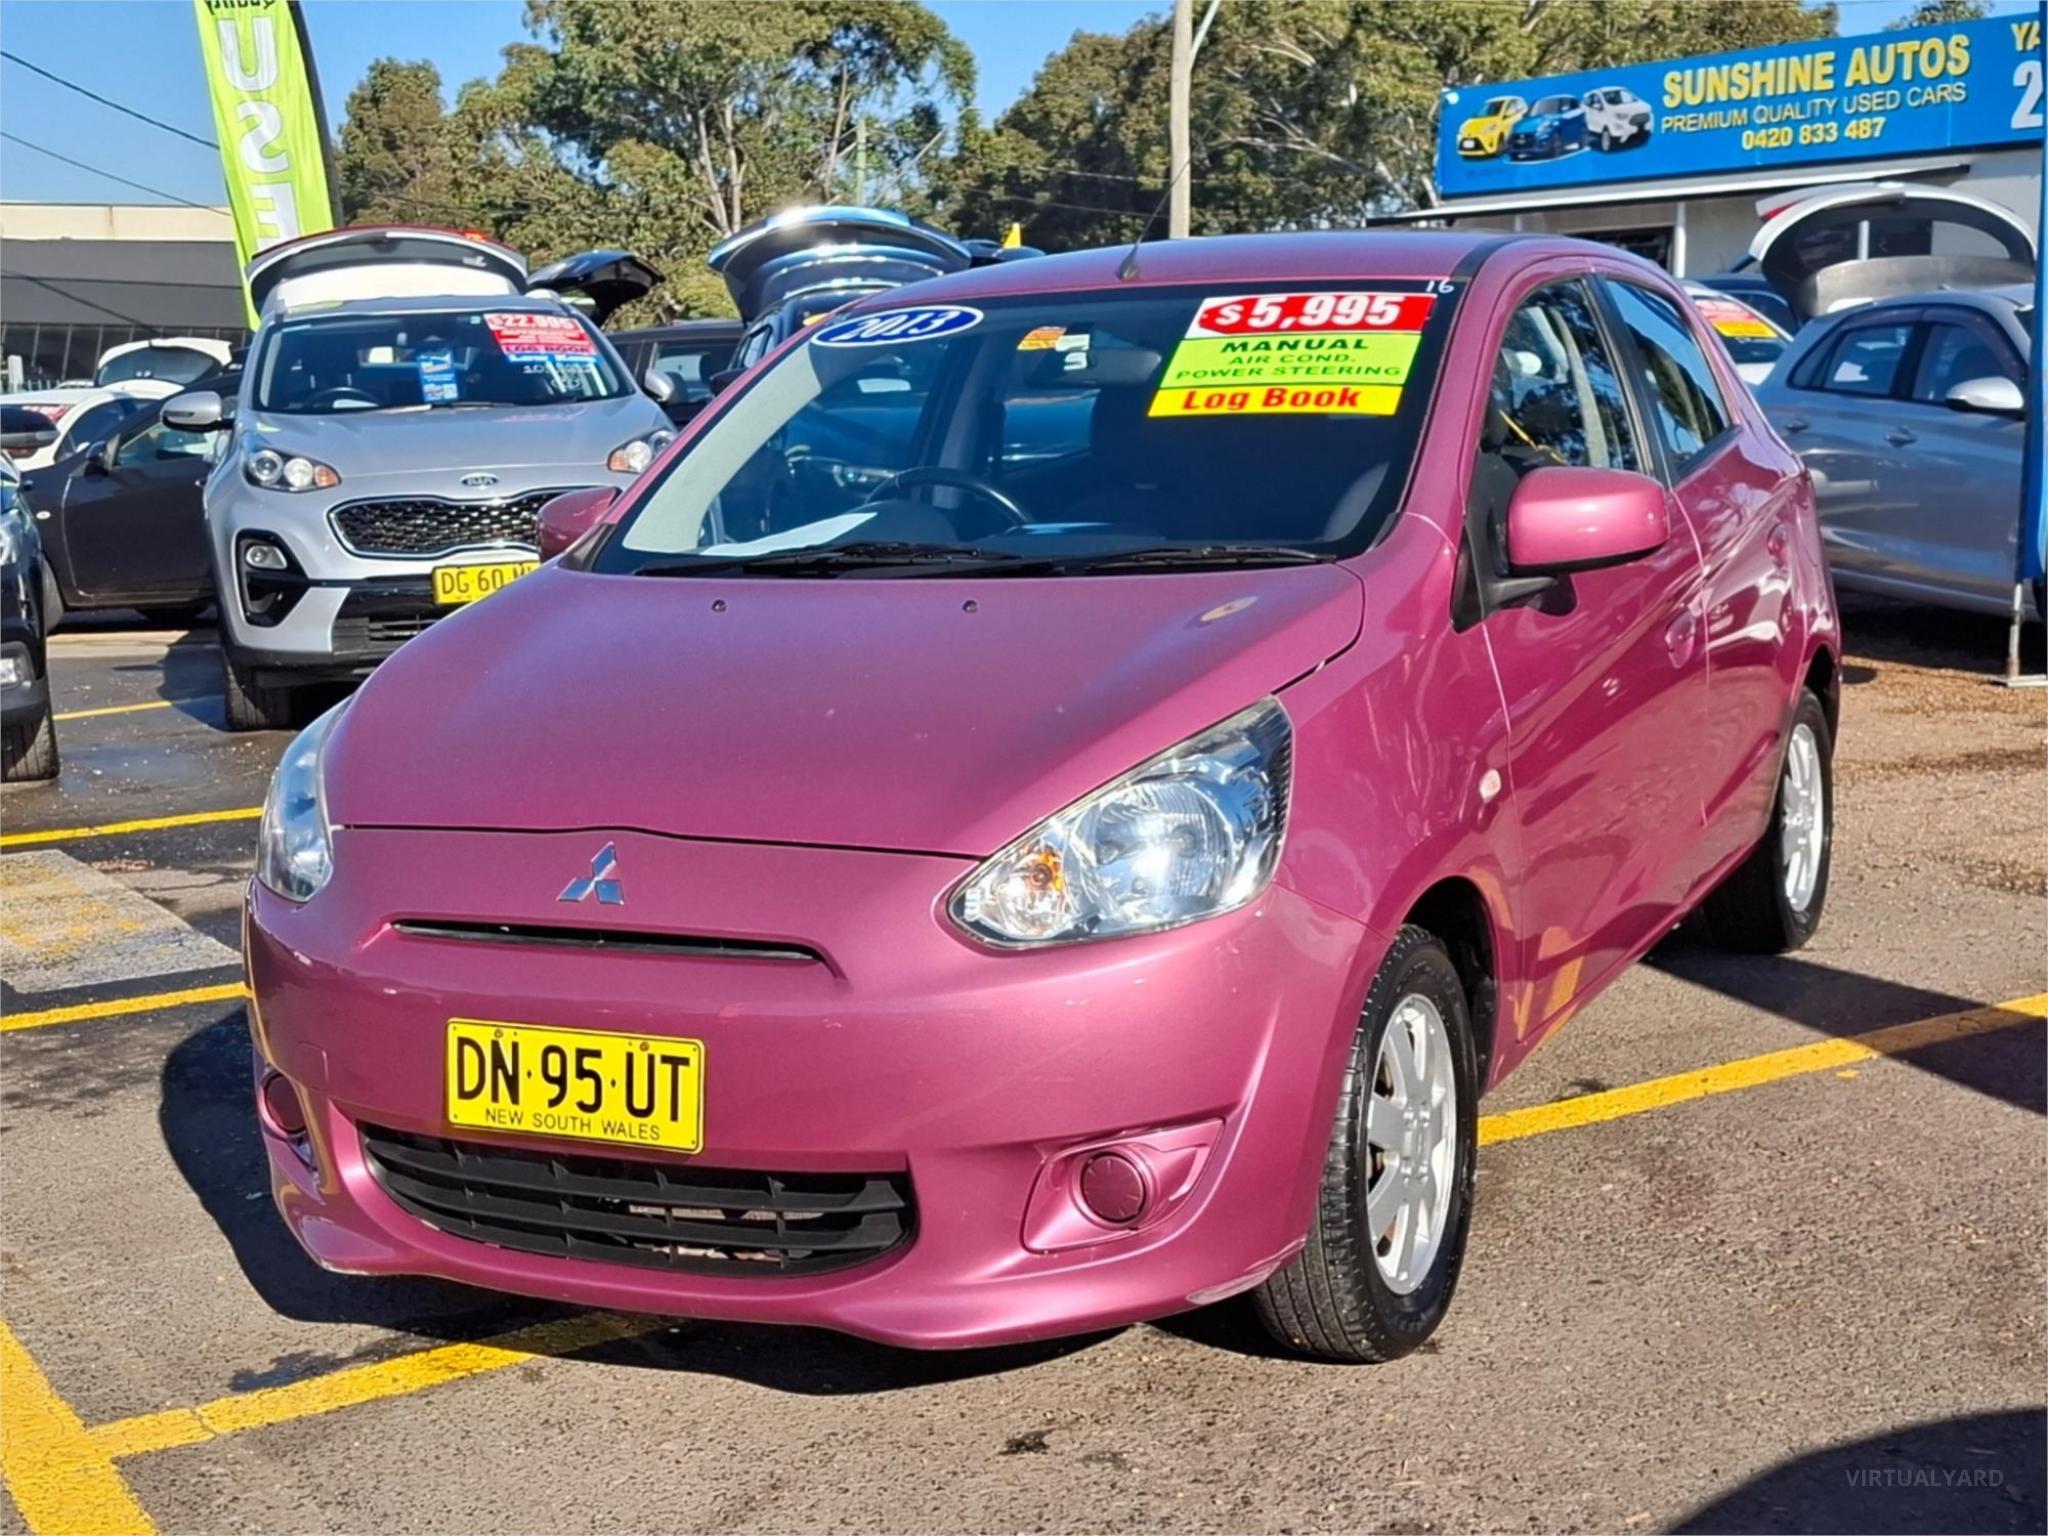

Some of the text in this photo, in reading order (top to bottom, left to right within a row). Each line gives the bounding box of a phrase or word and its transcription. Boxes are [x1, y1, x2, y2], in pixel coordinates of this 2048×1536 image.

[1663, 34, 1970, 108] SUNSHINE AUTOS
[1661, 82, 1966, 134] PREMIUM QUALITY USED CARS
[1741, 116, 1886, 150] 0420 833 487
[1426, 280, 1455, 293] 16
[829, 310, 963, 341] 2013
[1215, 295, 1405, 329] $5,995
[1220, 338, 1370, 353] MANUAL
[1228, 353, 1355, 365] AIR COND.
[1176, 366, 1401, 379] POWER STEERING
[1182, 387, 1362, 411] Log Book
[486, 1108, 661, 1141] NEW SOUTH WALES
